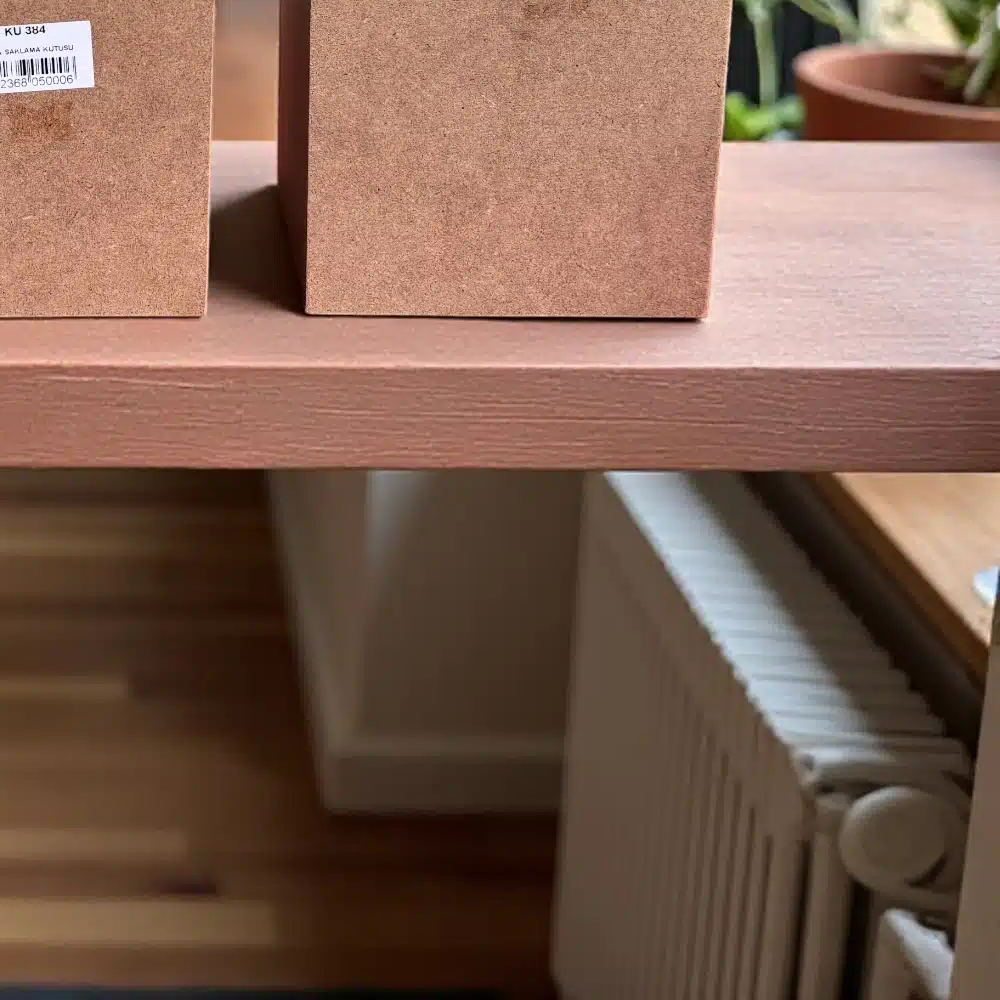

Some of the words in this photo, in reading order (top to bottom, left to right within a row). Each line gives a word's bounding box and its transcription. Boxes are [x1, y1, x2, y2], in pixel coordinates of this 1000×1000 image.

[5, 27, 22, 37] KU
[26, 25, 46, 35] 384
[4, 46, 41, 55] SAKLAMA
[43, 44, 74, 52] KUTUSU
